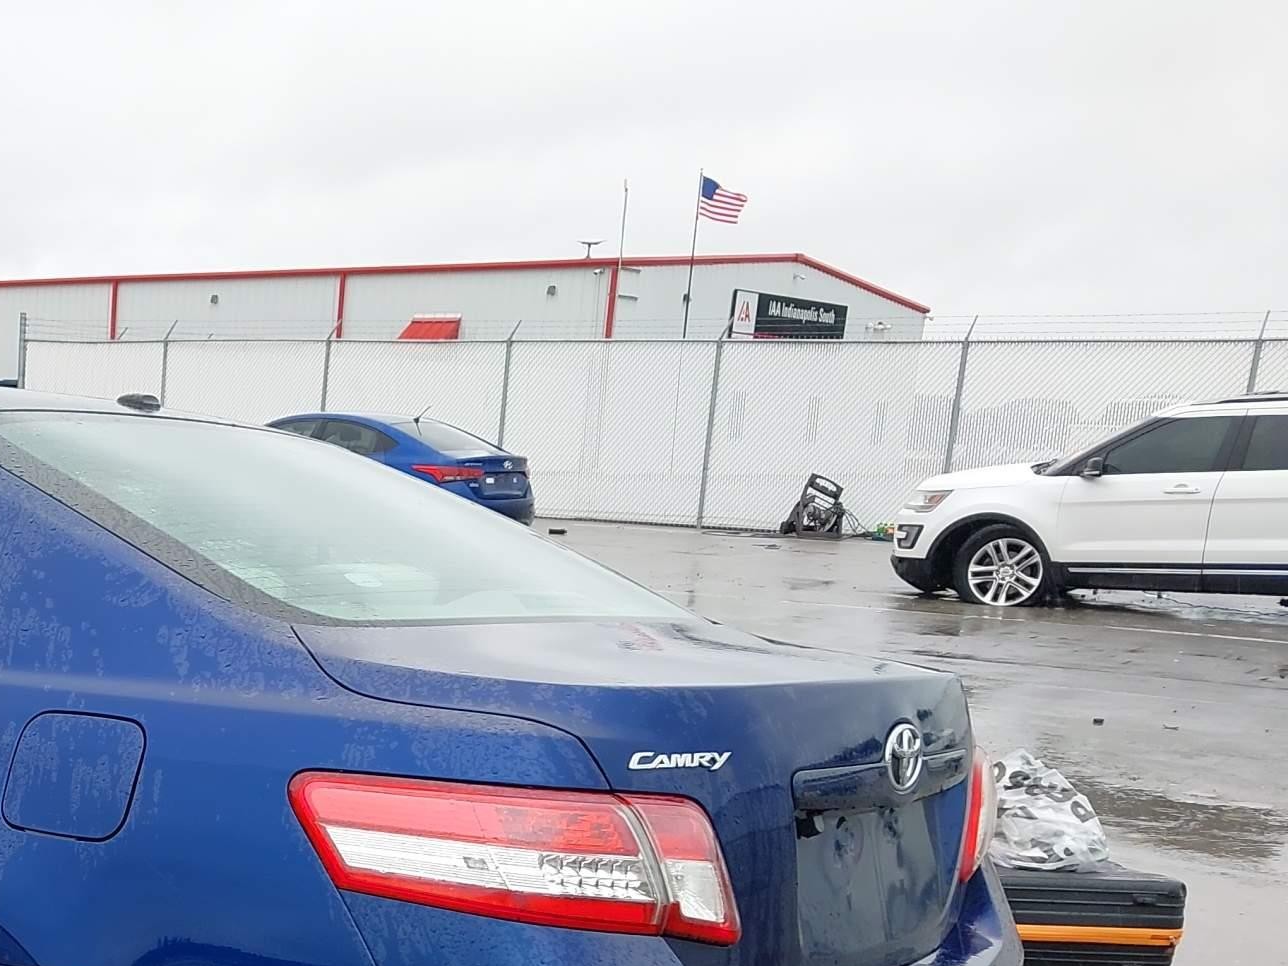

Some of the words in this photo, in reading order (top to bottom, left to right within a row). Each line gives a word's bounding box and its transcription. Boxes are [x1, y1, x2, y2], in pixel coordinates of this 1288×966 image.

[768, 300, 782, 316] IAA
[782, 302, 818, 323] Indianapolis
[819, 307, 836, 324] South
